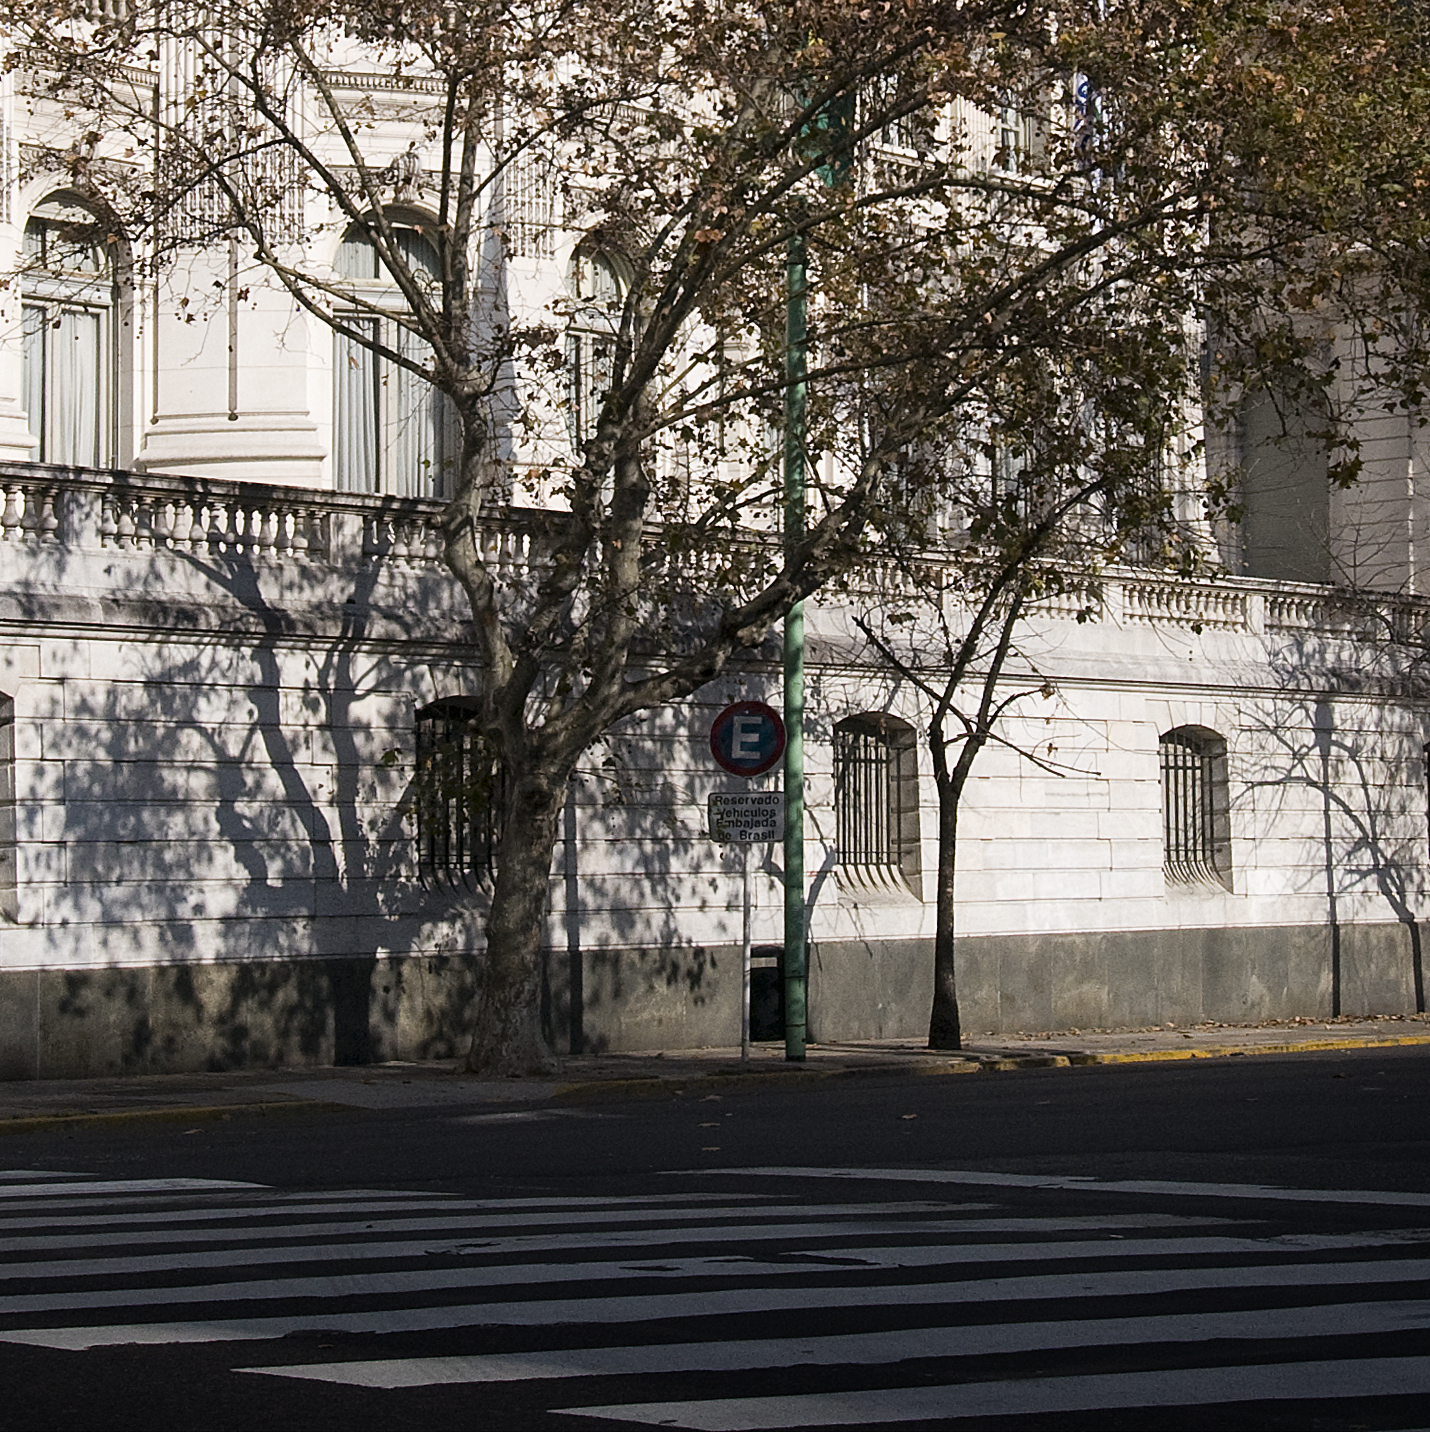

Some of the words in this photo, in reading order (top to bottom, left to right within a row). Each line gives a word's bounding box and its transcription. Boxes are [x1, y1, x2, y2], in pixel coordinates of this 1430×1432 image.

[731, 716, 763, 760] E
[715, 795, 780, 806] Reservado
[716, 818, 777, 830] Embajada
[718, 830, 732, 841] de
[739, 829, 775, 841] Brasil
